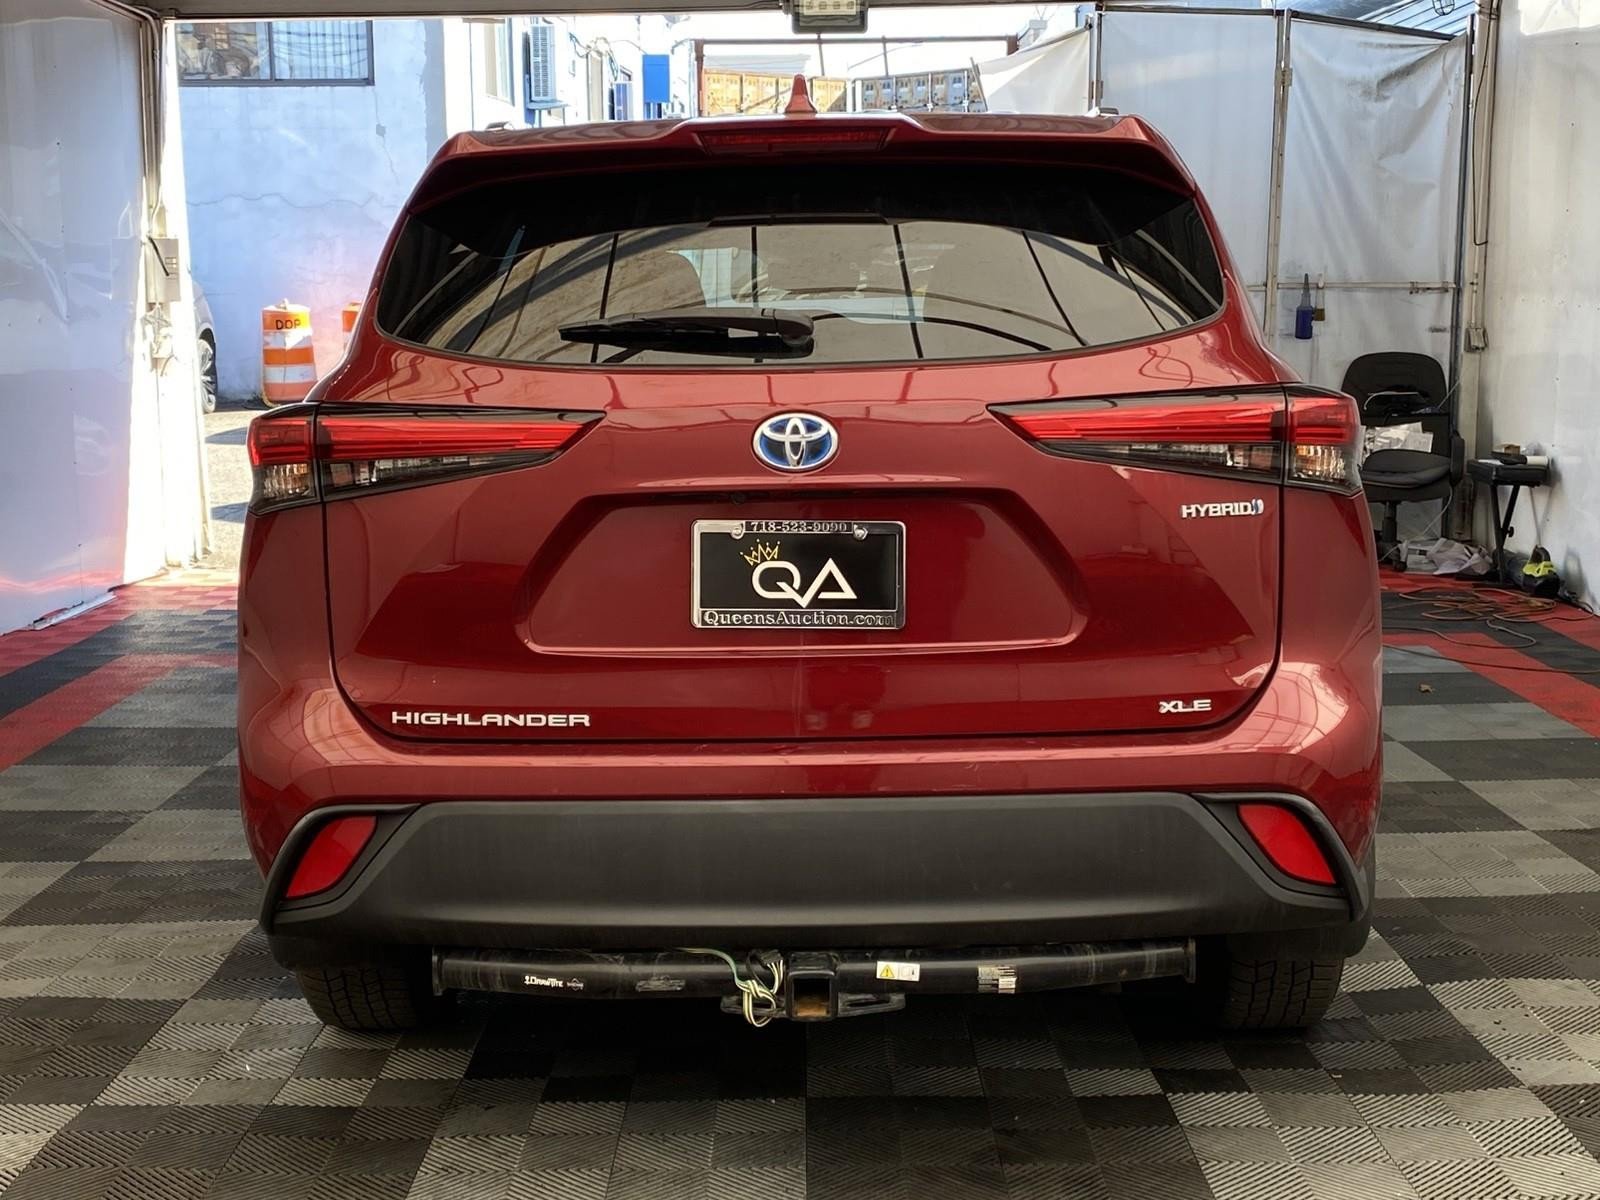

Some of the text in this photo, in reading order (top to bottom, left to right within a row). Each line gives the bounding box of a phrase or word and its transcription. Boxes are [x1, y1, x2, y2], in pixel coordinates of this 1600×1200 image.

[1181, 502, 1252, 518] HYBRID
[750, 520, 848, 532] 718-523-9090
[751, 557, 858, 609] QA
[703, 610, 895, 626] QueensAuction.com
[1158, 699, 1212, 714] XLE
[391, 711, 591, 727] HIGHLANDER
